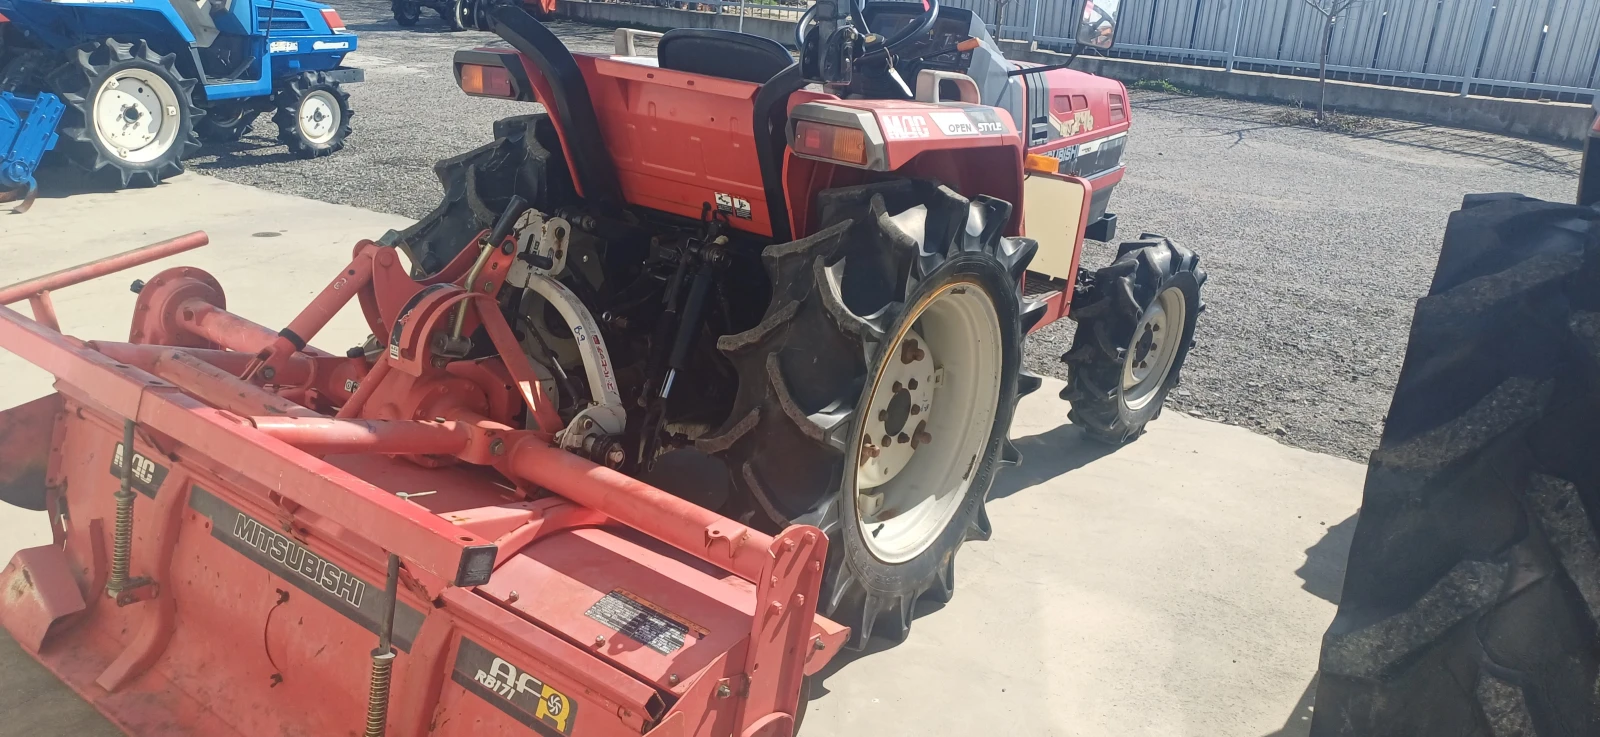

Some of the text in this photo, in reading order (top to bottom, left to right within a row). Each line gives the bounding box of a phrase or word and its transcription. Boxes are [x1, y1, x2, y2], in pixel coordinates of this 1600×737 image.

[948, 122, 1003, 133] OPEN STYLE
[233, 512, 366, 609] MITSUBISHI
[473, 669, 515, 701] RB171
